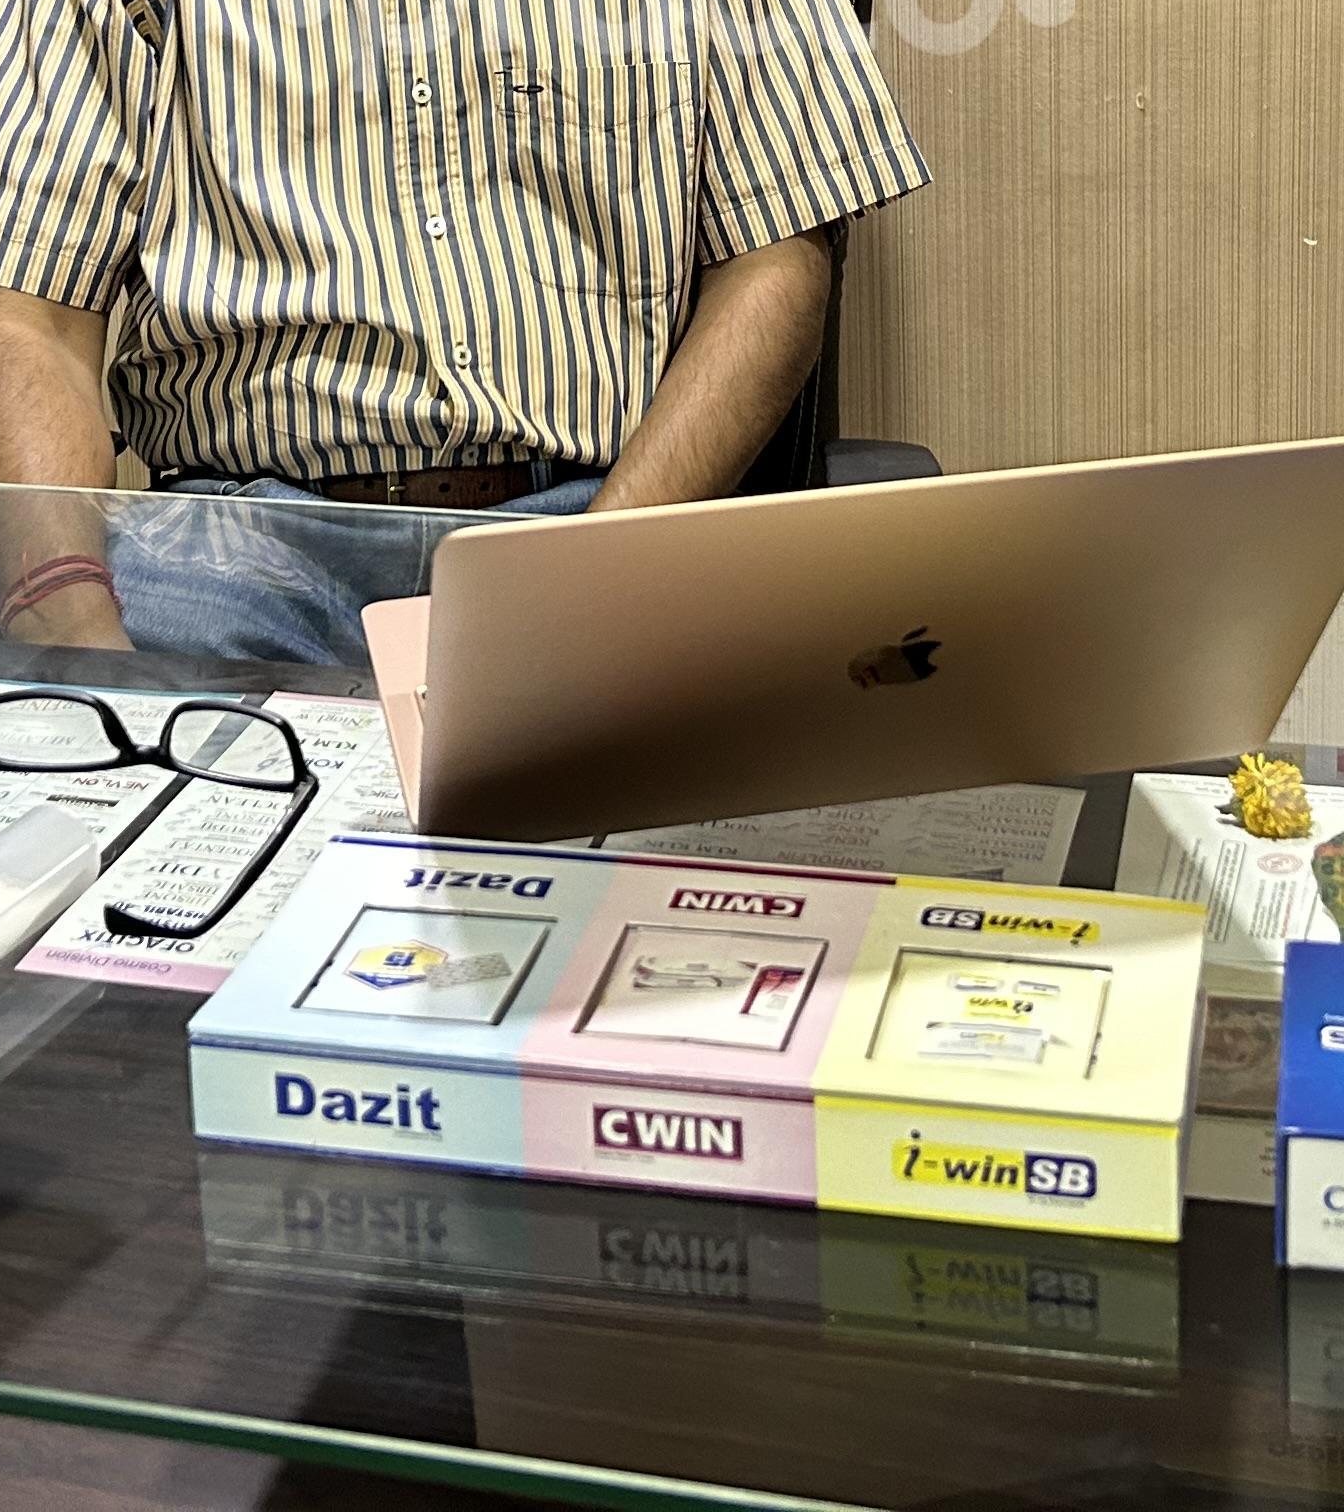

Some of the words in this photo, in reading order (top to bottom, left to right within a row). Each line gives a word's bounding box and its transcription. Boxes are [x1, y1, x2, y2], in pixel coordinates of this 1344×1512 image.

[404, 869, 555, 899] Dazit
[678, 892, 799, 916] CWIN
[46, 950, 111, 966] Division
[113, 959, 172, 975] Cosmo
[274, 1071, 441, 1132] Dazit
[599, 1109, 736, 1155] CWIN
